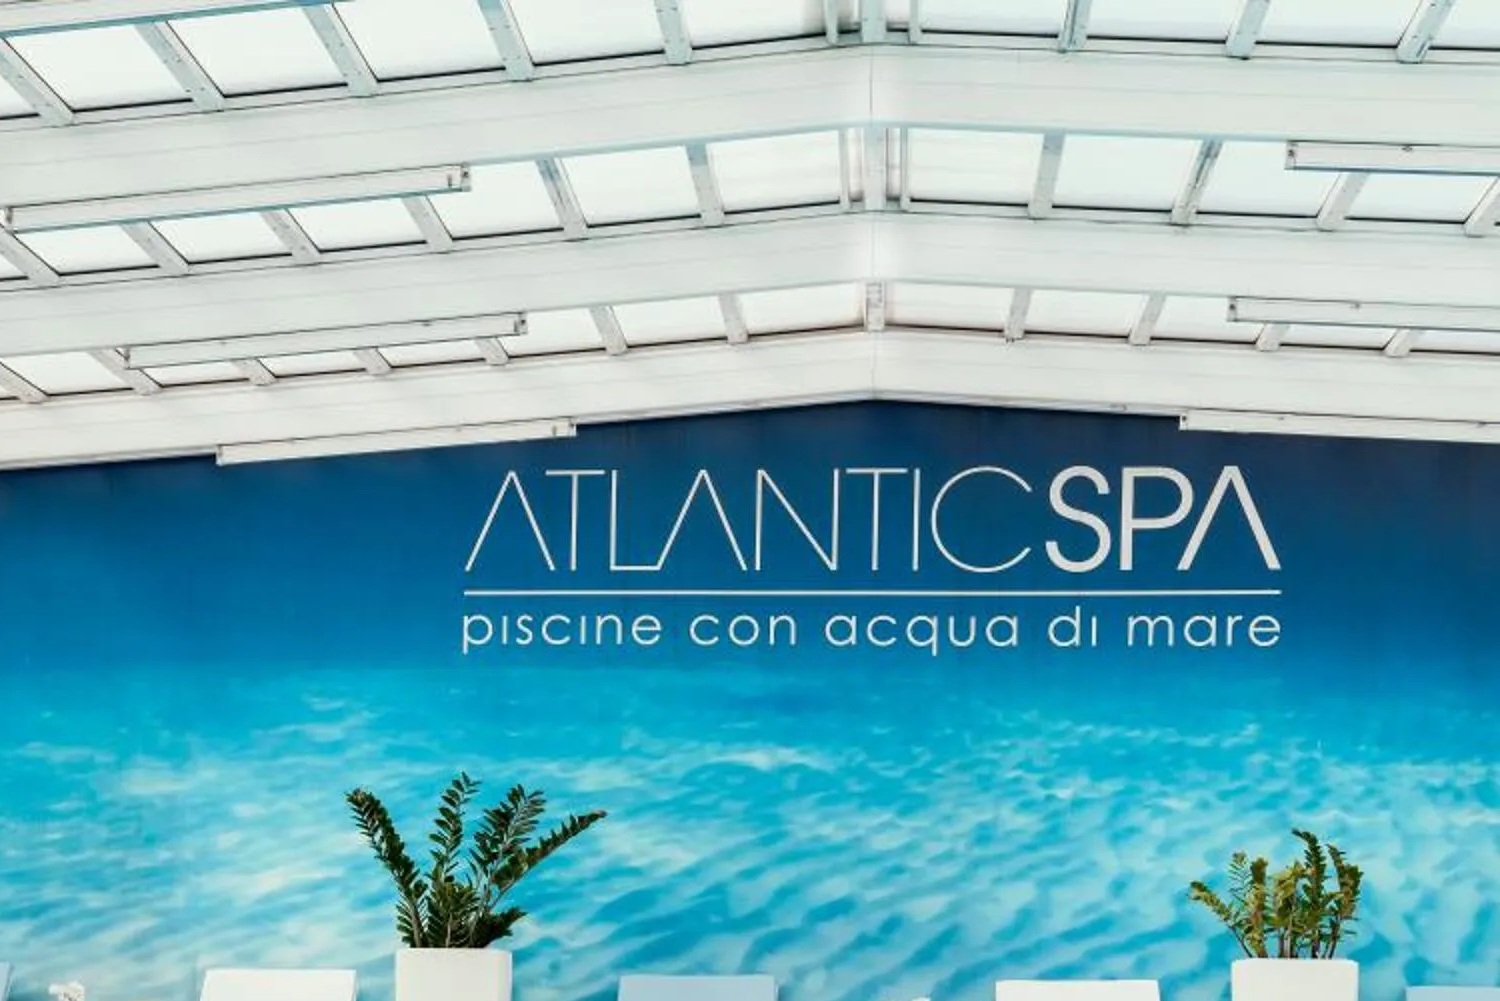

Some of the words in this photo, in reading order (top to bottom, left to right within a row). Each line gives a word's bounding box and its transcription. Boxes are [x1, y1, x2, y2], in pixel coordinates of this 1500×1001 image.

[461, 613, 663, 655] piscine
[688, 613, 798, 646] con
[823, 613, 1019, 657] acqua
[1046, 605, 1099, 648] di
[1126, 613, 1282, 648] mare
